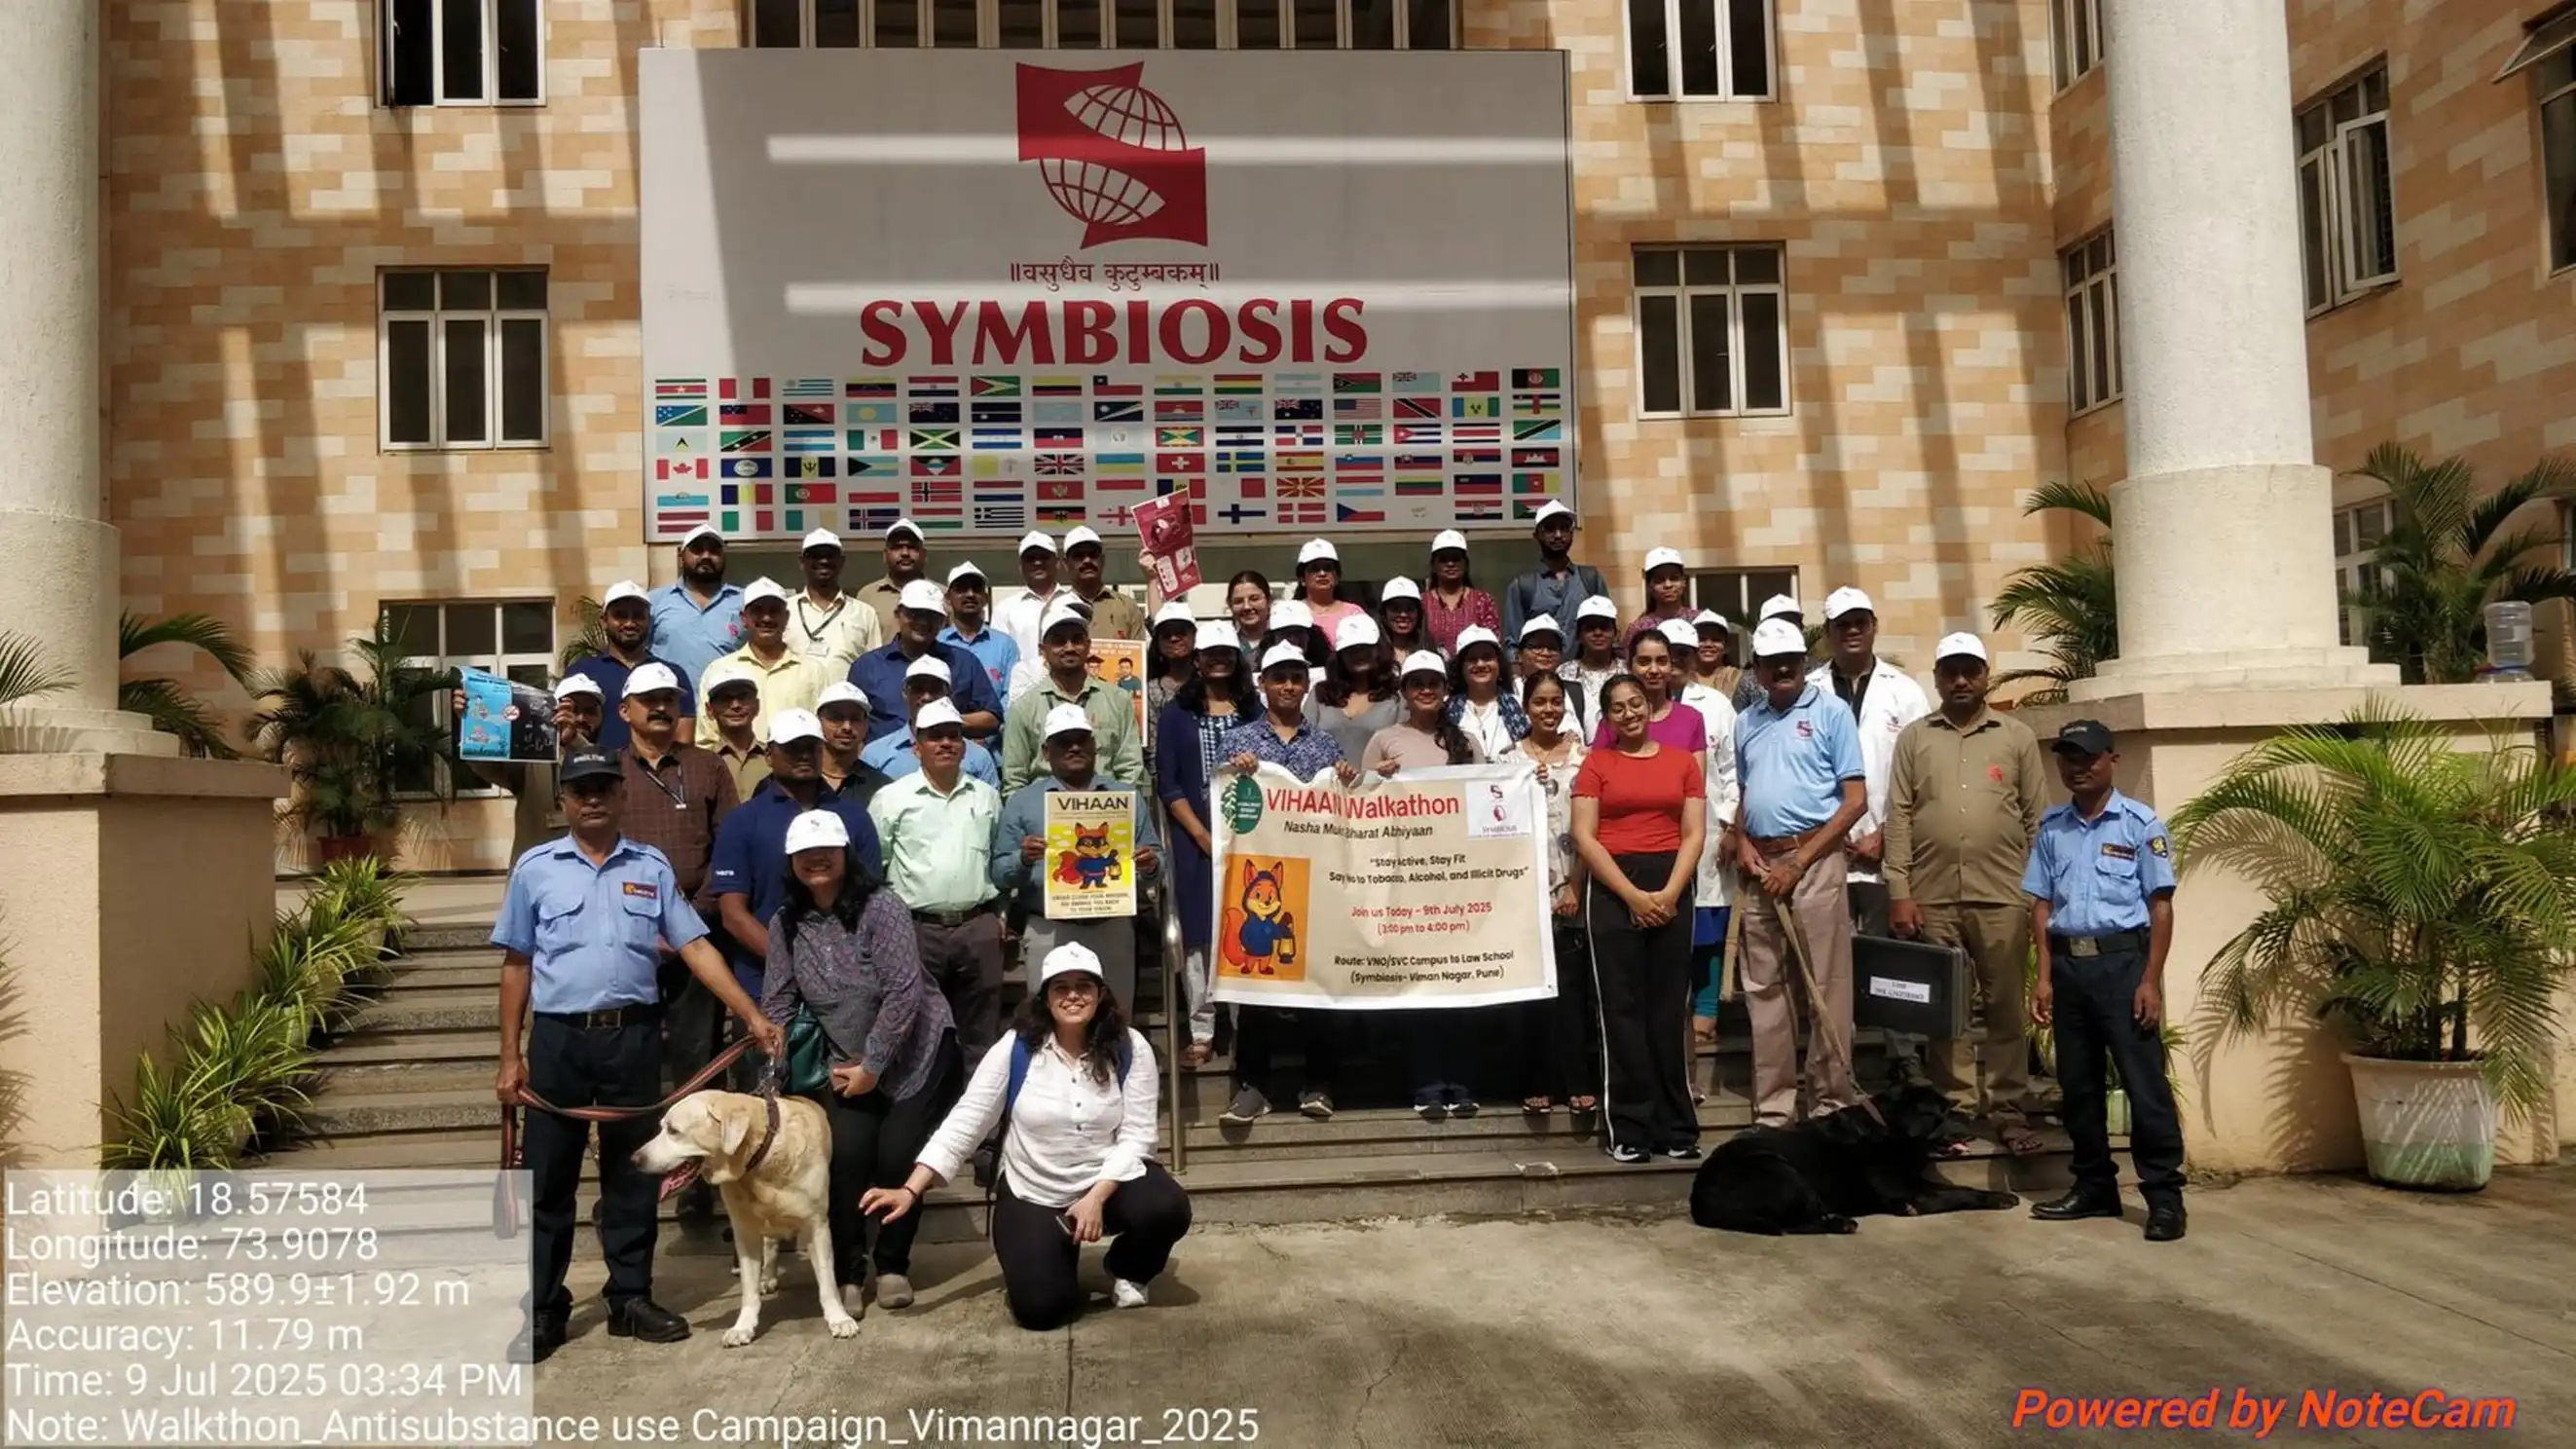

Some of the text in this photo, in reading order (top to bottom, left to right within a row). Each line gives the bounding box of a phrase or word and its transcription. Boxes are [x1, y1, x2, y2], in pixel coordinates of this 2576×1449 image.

[861, 298, 1368, 365] SYMBIOSIS
[1057, 797, 1128, 810] VIHAAN
[1344, 792, 1460, 820] Walkathon
[1283, 820, 1320, 835] Nasha
[1381, 825, 1433, 839] Abhiyaan
[1429, 855, 1452, 868] Stay
[1454, 853, 1466, 864] Fit
[1329, 871, 1345, 884] Say
[1409, 872, 1448, 882] Alcohol,
[1450, 870, 1468, 880] and
[1470, 869, 1493, 879] Illicit
[1351, 906, 1369, 917] Join
[1371, 908, 1383, 917] us
[1386, 907, 1414, 919] Today
[1422, 905, 1441, 915] 9th
[1443, 904, 1465, 917] July
[1467, 902, 1493, 913] 2025
[1400, 925, 1415, 935] pm
[1416, 924, 1425, 933] to
[1427, 922, 1448, 932] 4:00
[1450, 919, 1470, 933] pm)
[1334, 955, 1365, 966] Route:
[1410, 954, 1449, 968] Campus
[1451, 954, 1460, 964] to
[1462, 952, 1482, 963] Law
[1482, 950, 1515, 962] School
[1410, 971, 1440, 982] Viman
[1476, 966, 1505, 980] Pune)
